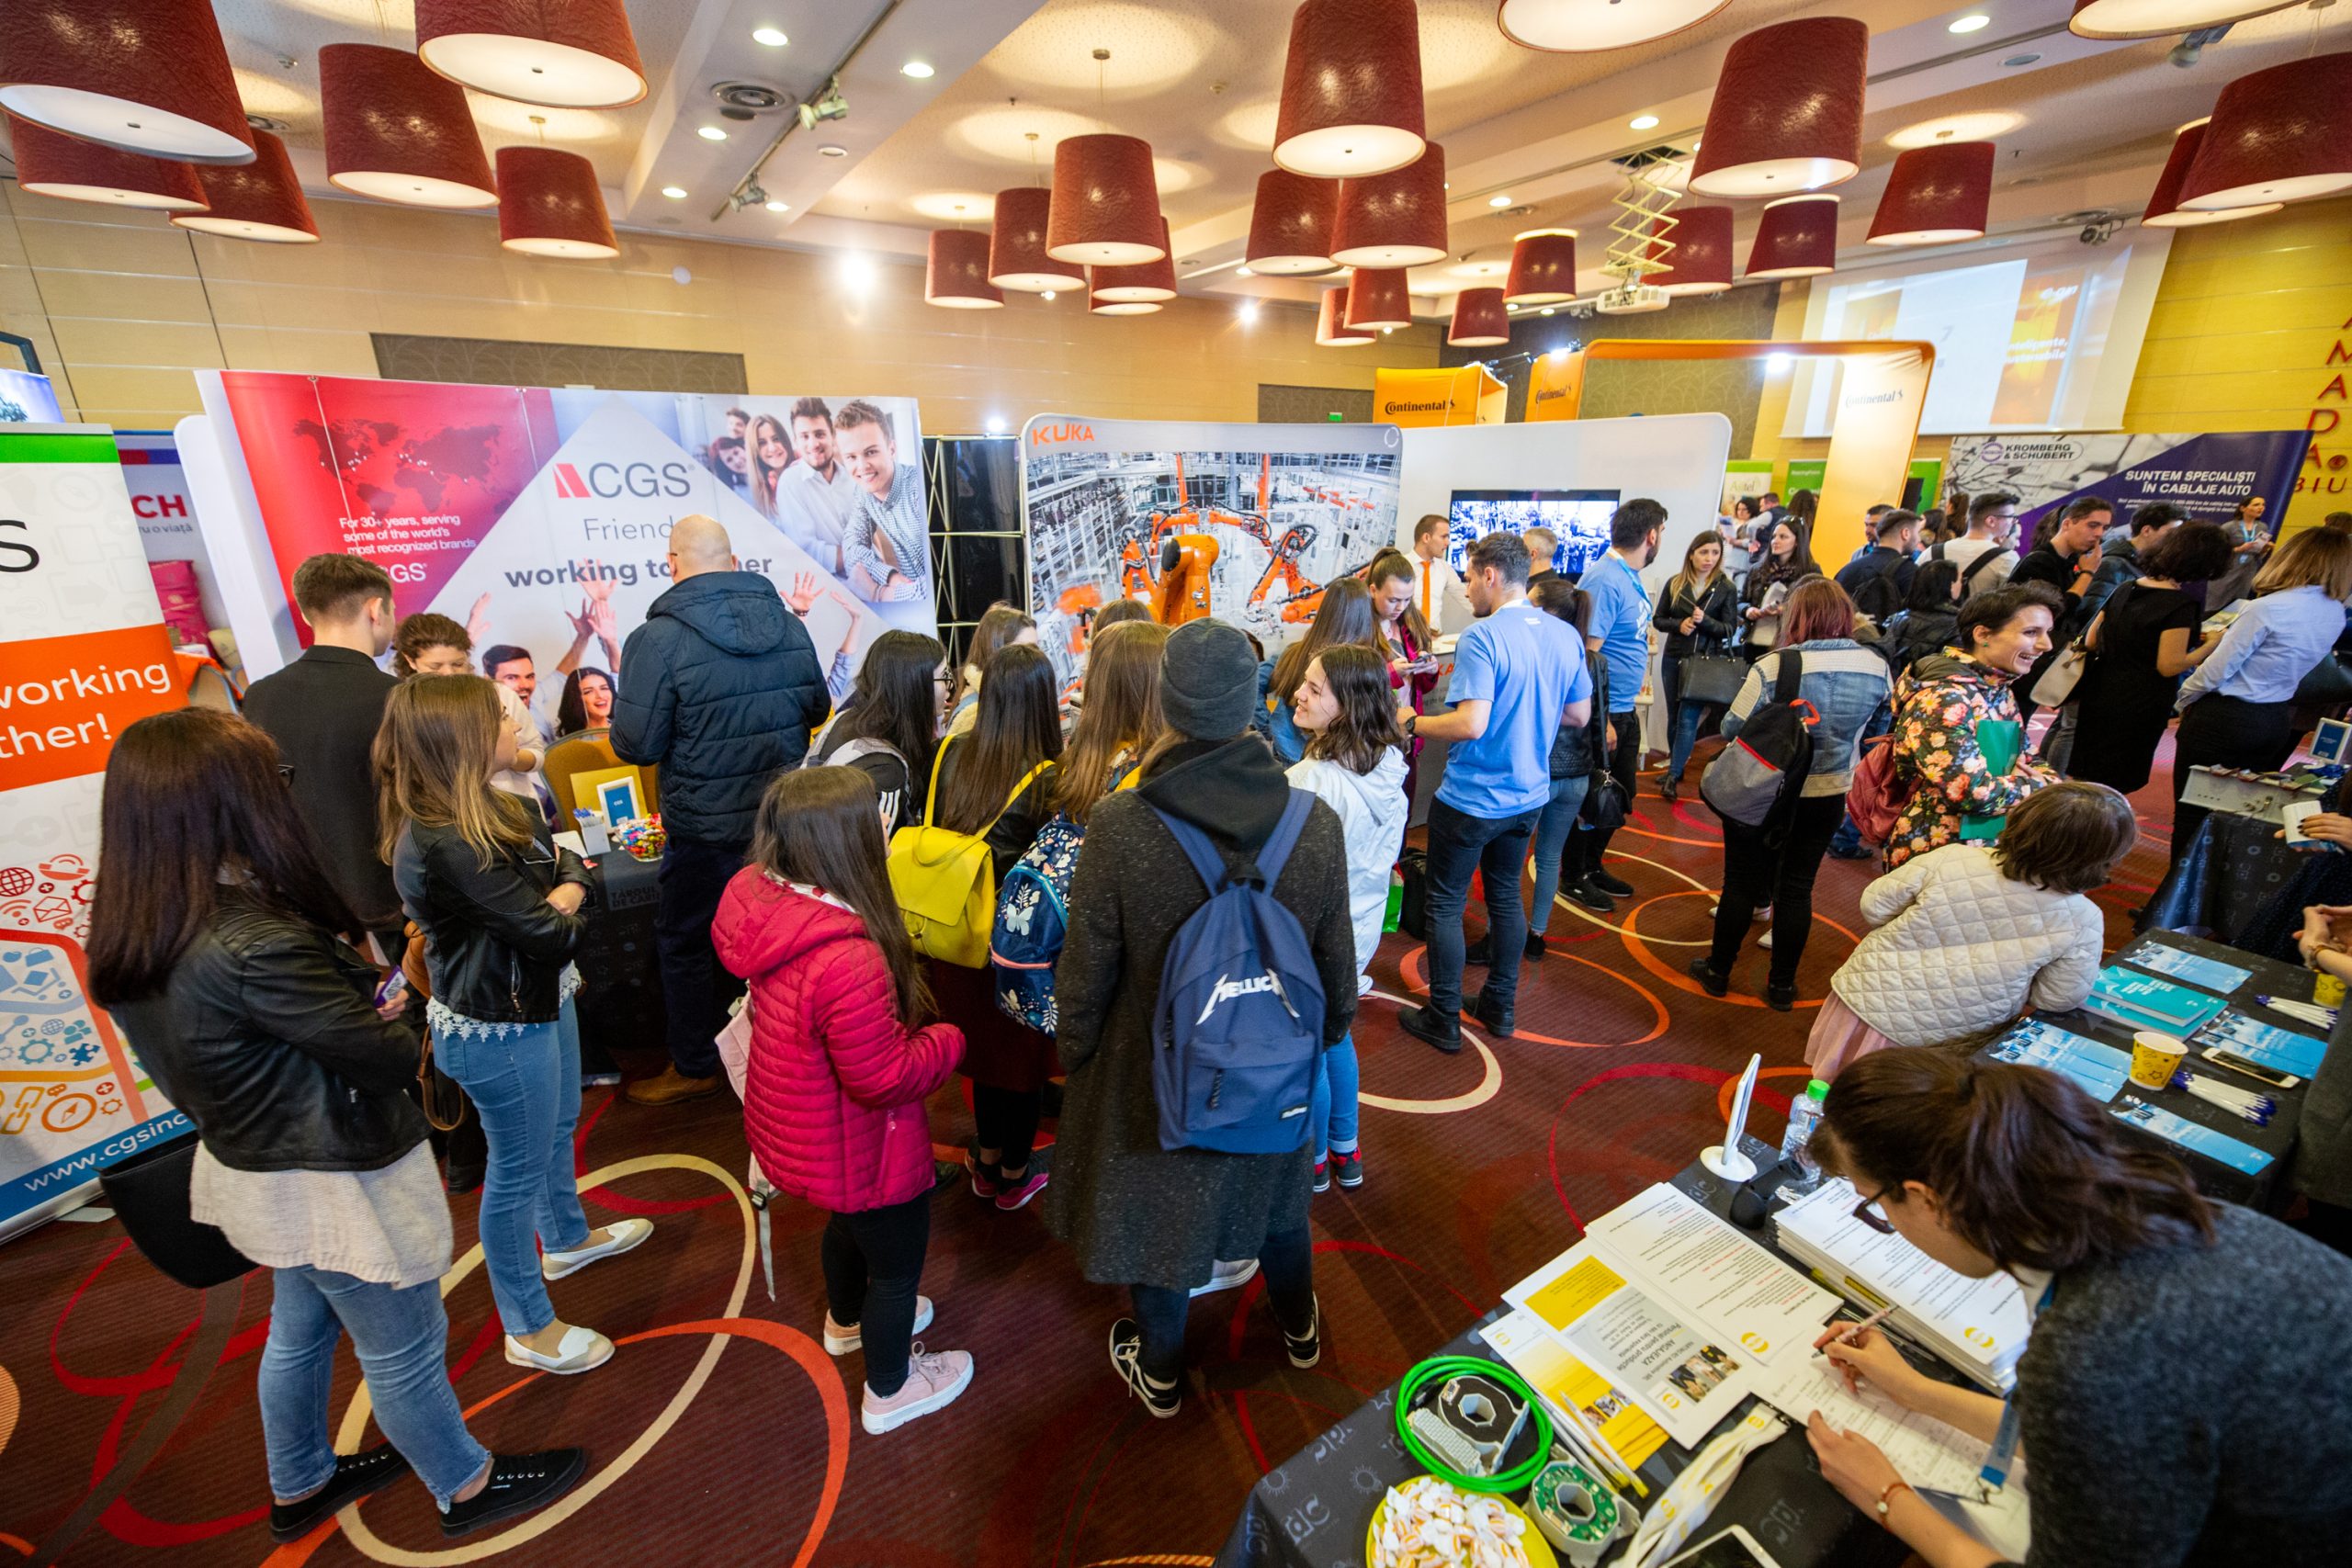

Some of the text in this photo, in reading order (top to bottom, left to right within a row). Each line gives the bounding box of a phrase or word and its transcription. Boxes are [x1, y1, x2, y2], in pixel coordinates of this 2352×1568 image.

[1845, 389, 1896, 407] Continental
[1385, 400, 1446, 415] Continental
[1032, 423, 1094, 446] KUKA
[2006, 444, 2071, 452] KROMBERG
[2125, 470, 2182, 481] SUNTEM
[2142, 481, 2251, 495] ÎN CABLAJE AUTO
[2294, 477, 2347, 493] BIU
[339, 514, 461, 529] For 30+ years, serving
[583, 515, 674, 541] Friend
[344, 531, 375, 543] some
[377, 529, 389, 540] of
[390, 529, 409, 540] the
[347, 537, 476, 555] most recognized brands
[505, 559, 638, 586] working
[24, 1112, 188, 1191] www.cgsinc
